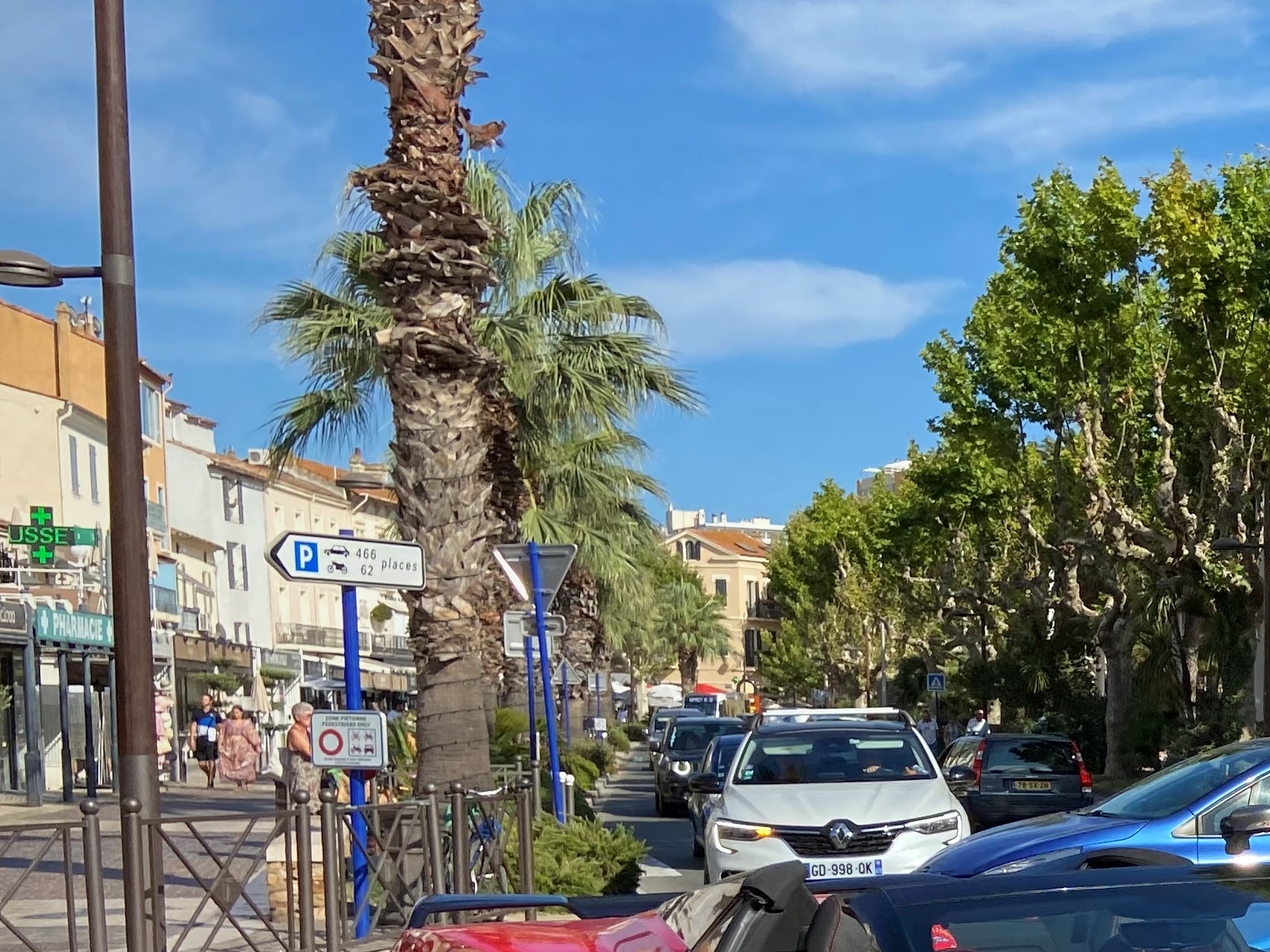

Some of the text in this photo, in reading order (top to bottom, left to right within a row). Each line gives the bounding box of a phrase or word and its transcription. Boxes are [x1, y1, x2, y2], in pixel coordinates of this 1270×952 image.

[299, 544, 313, 569] P
[355, 548, 377, 560] 466
[360, 565, 374, 576] 62
[381, 558, 418, 572] places
[53, 614, 103, 640] PHARMACIE
